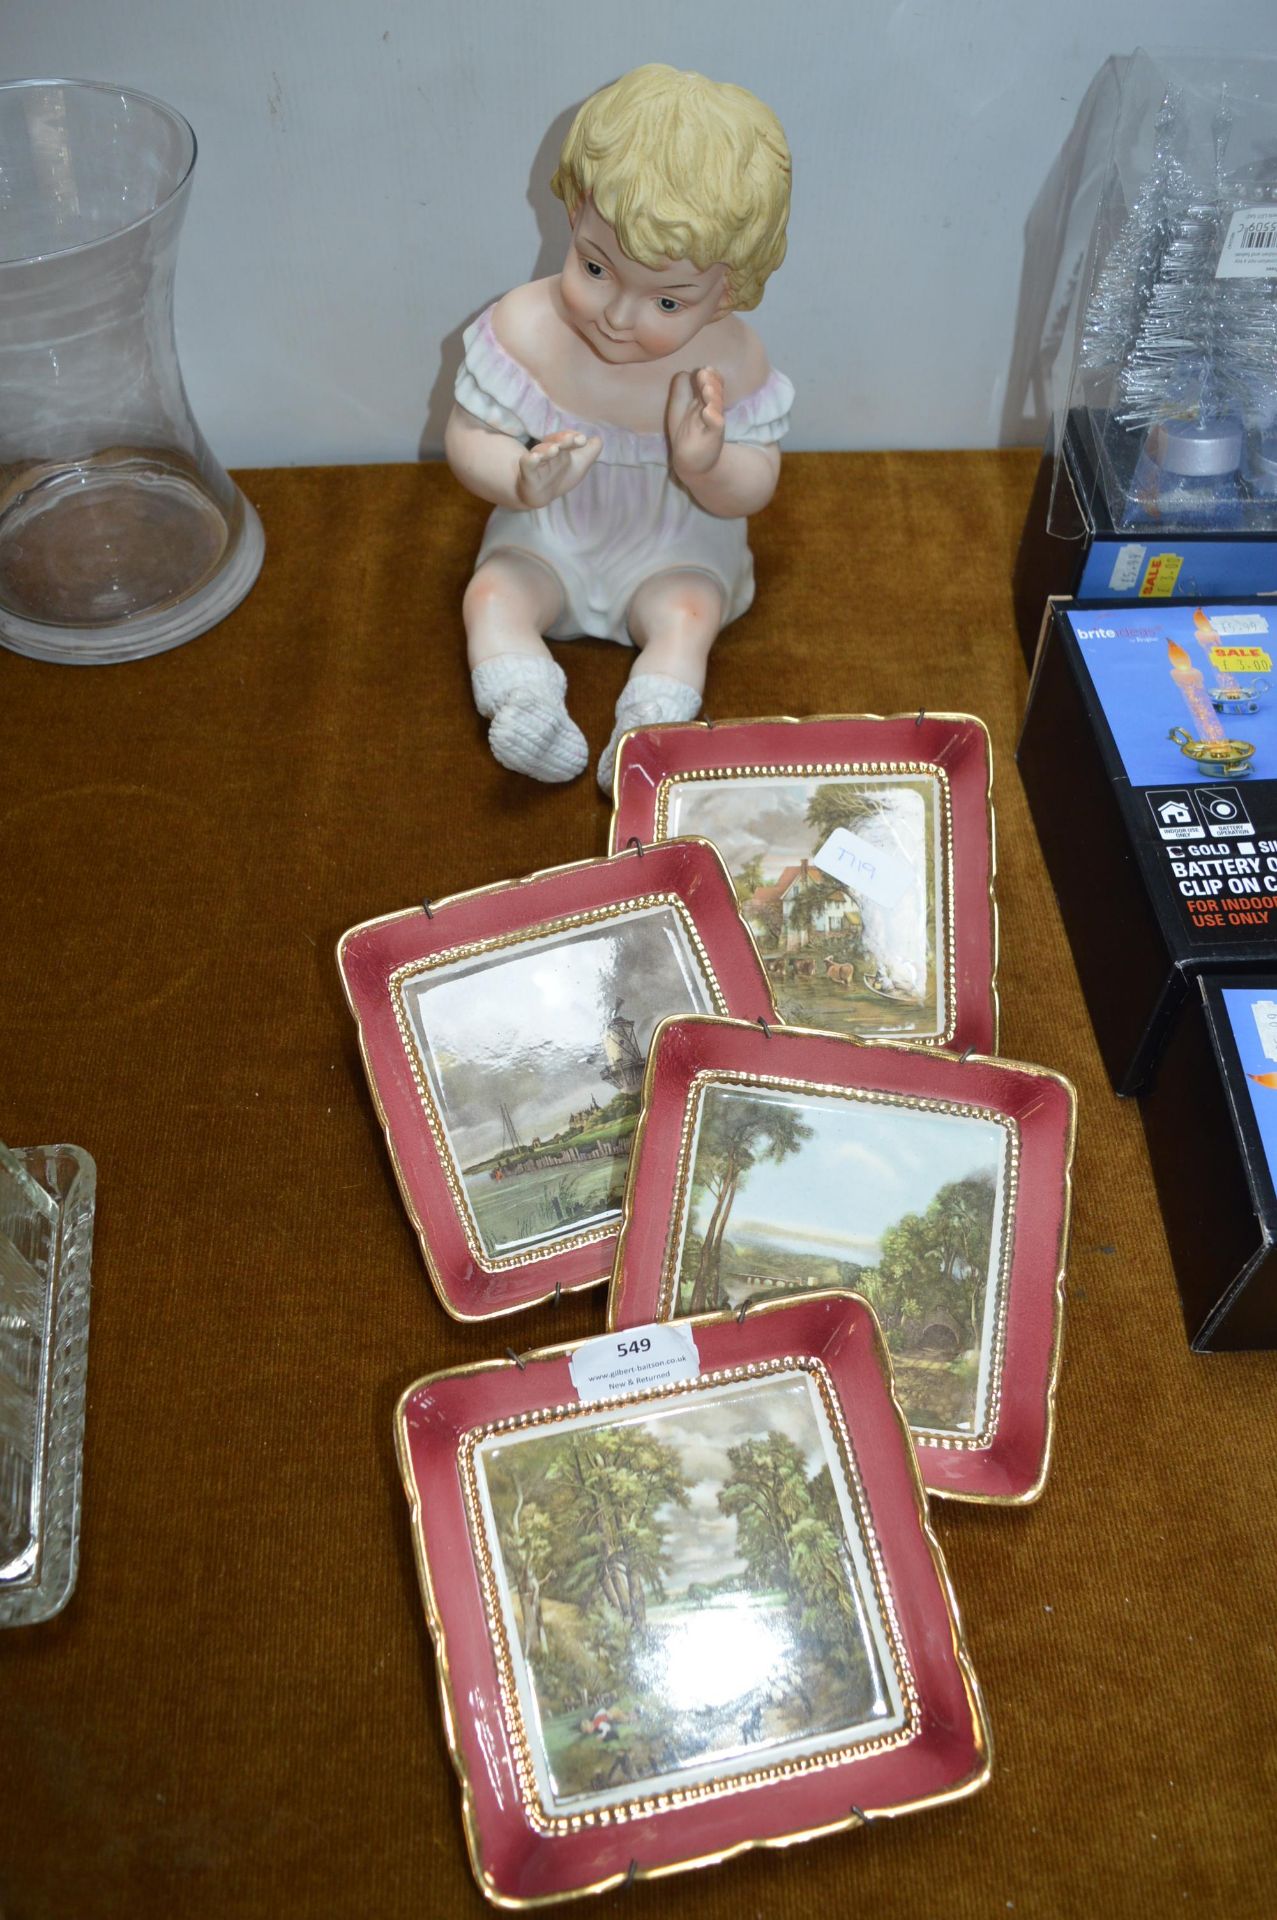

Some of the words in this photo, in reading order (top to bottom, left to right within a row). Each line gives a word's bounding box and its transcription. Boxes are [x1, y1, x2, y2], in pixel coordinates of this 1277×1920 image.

[1142, 559, 1162, 595] SALE
[1215, 648, 1262, 657] SALE
[1188, 844, 1230, 856] GOLD
[1171, 857, 1261, 878] BATTERY
[1178, 879, 1223, 896] CLIP
[1228, 877, 1261, 894] ON
[1186, 899, 1219, 913] FOR
[1192, 914, 1226, 927] USE
[1228, 911, 1269, 926] ONLY
[617, 1338, 651, 1357] 549
[588, 1355, 687, 1382] www.gilbert-baitson.co.uk
[636, 1371, 671, 1384] Returned
